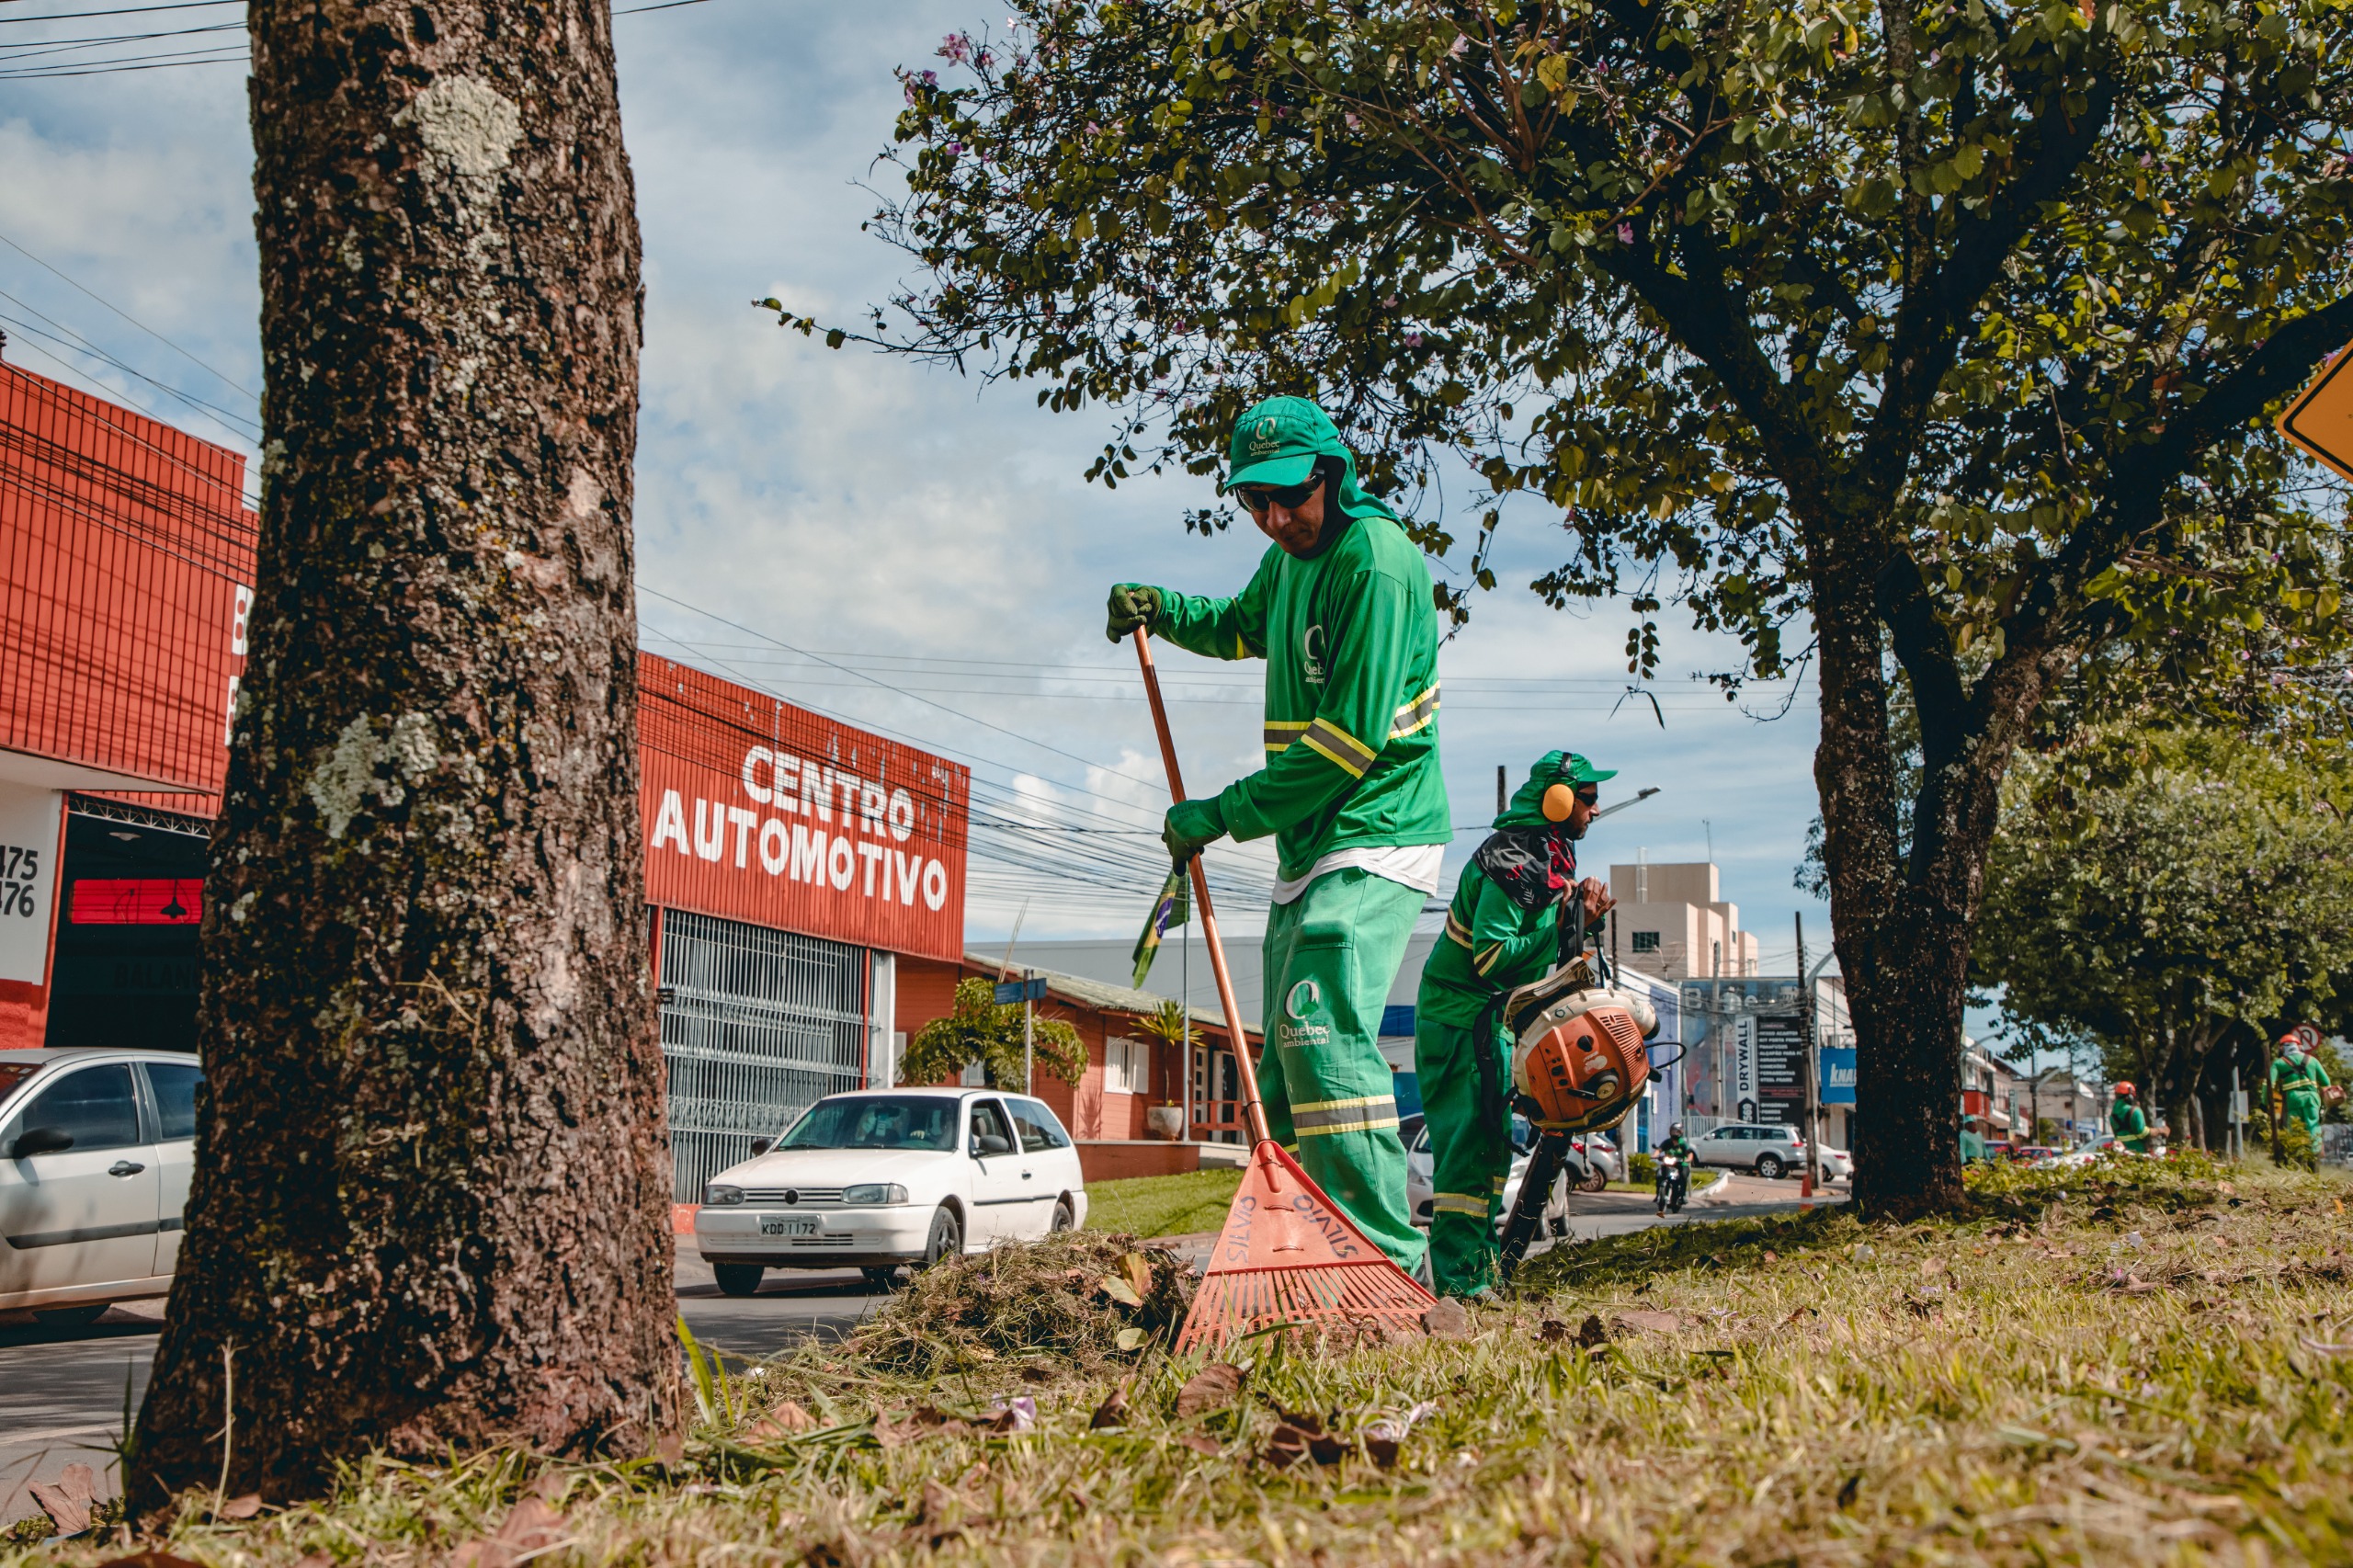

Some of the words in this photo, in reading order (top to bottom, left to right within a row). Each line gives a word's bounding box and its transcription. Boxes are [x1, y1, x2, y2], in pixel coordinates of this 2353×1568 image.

[1249, 439, 1279, 451] Quebec
[742, 745, 914, 842] CENTRO
[651, 788, 947, 912] AUTOMOTIVO
[0, 881, 35, 917] 76
[1279, 1020, 1331, 1040] Quebec
[1283, 1034, 1330, 1048] ambiental
[1738, 1021, 1748, 1092] DRYWALL
[1227, 1196, 1256, 1263] SILVIO
